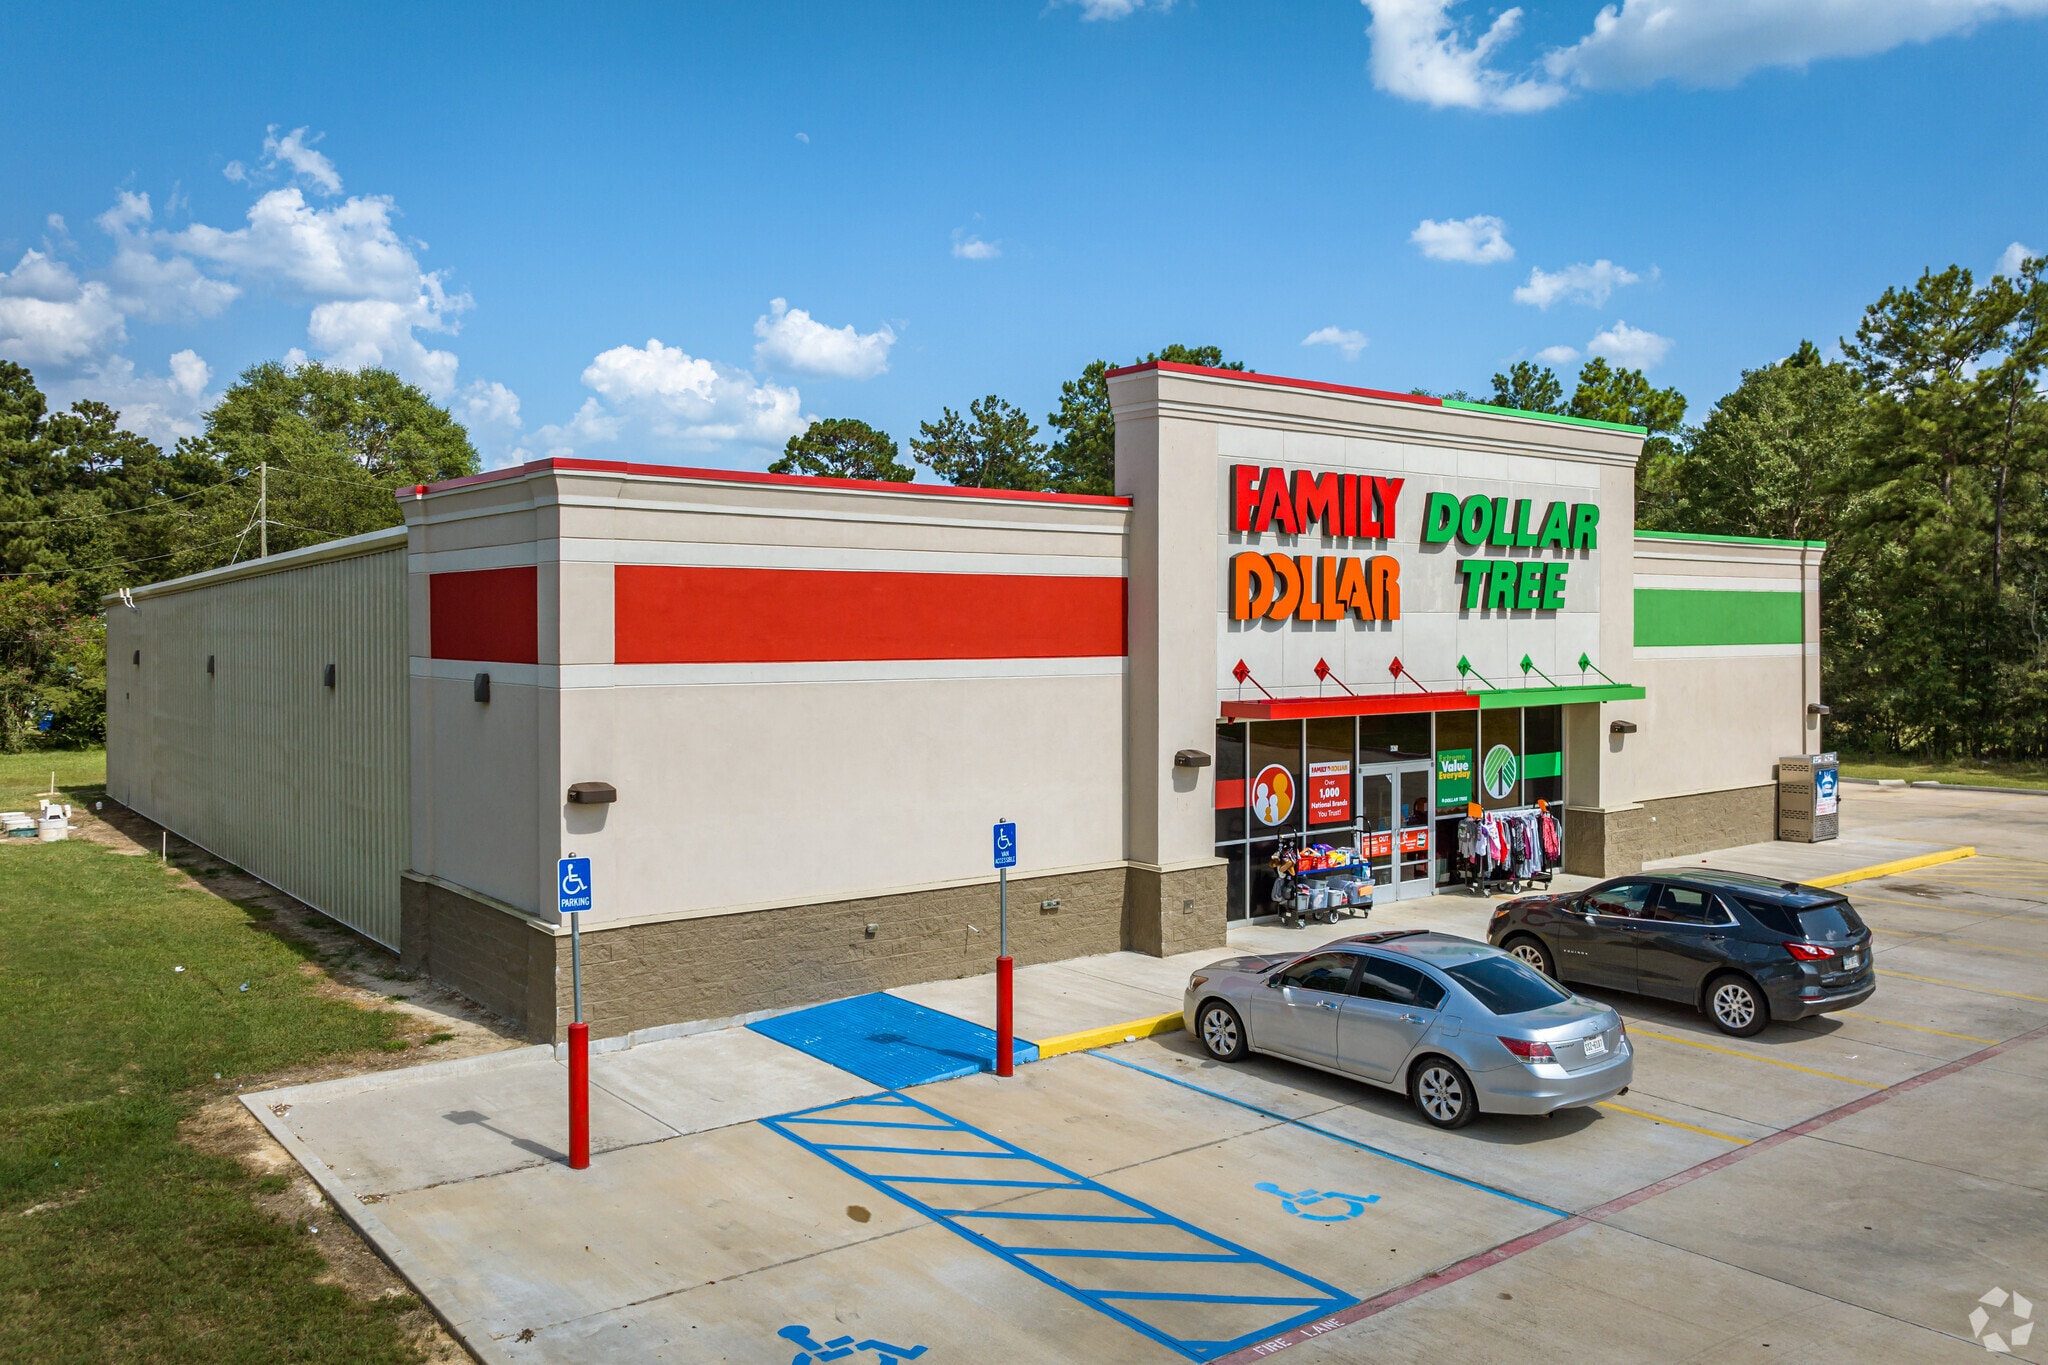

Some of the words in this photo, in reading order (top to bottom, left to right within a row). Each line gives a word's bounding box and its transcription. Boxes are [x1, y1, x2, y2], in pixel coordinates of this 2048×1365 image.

[1230, 464, 1405, 539] FAMILY
[1425, 492, 1600, 549] DOLLAR
[1230, 551, 1400, 620] DOLLAR
[1458, 559, 1569, 609] TREE
[1439, 754, 1465, 762] Extreme
[1331, 764, 1348, 772] DOLLAR
[1441, 760, 1469, 772] Value
[1439, 770, 1470, 780] Everyday
[1319, 787, 1340, 799] 1,000
[1311, 801, 1332, 809] National
[1332, 799, 1348, 807] Brands
[1328, 809, 1341, 817] Trust!
[561, 897, 590, 908] PARKING
[1252, 1337, 1293, 1356] FIRE
[1300, 1318, 1346, 1338] LANE
